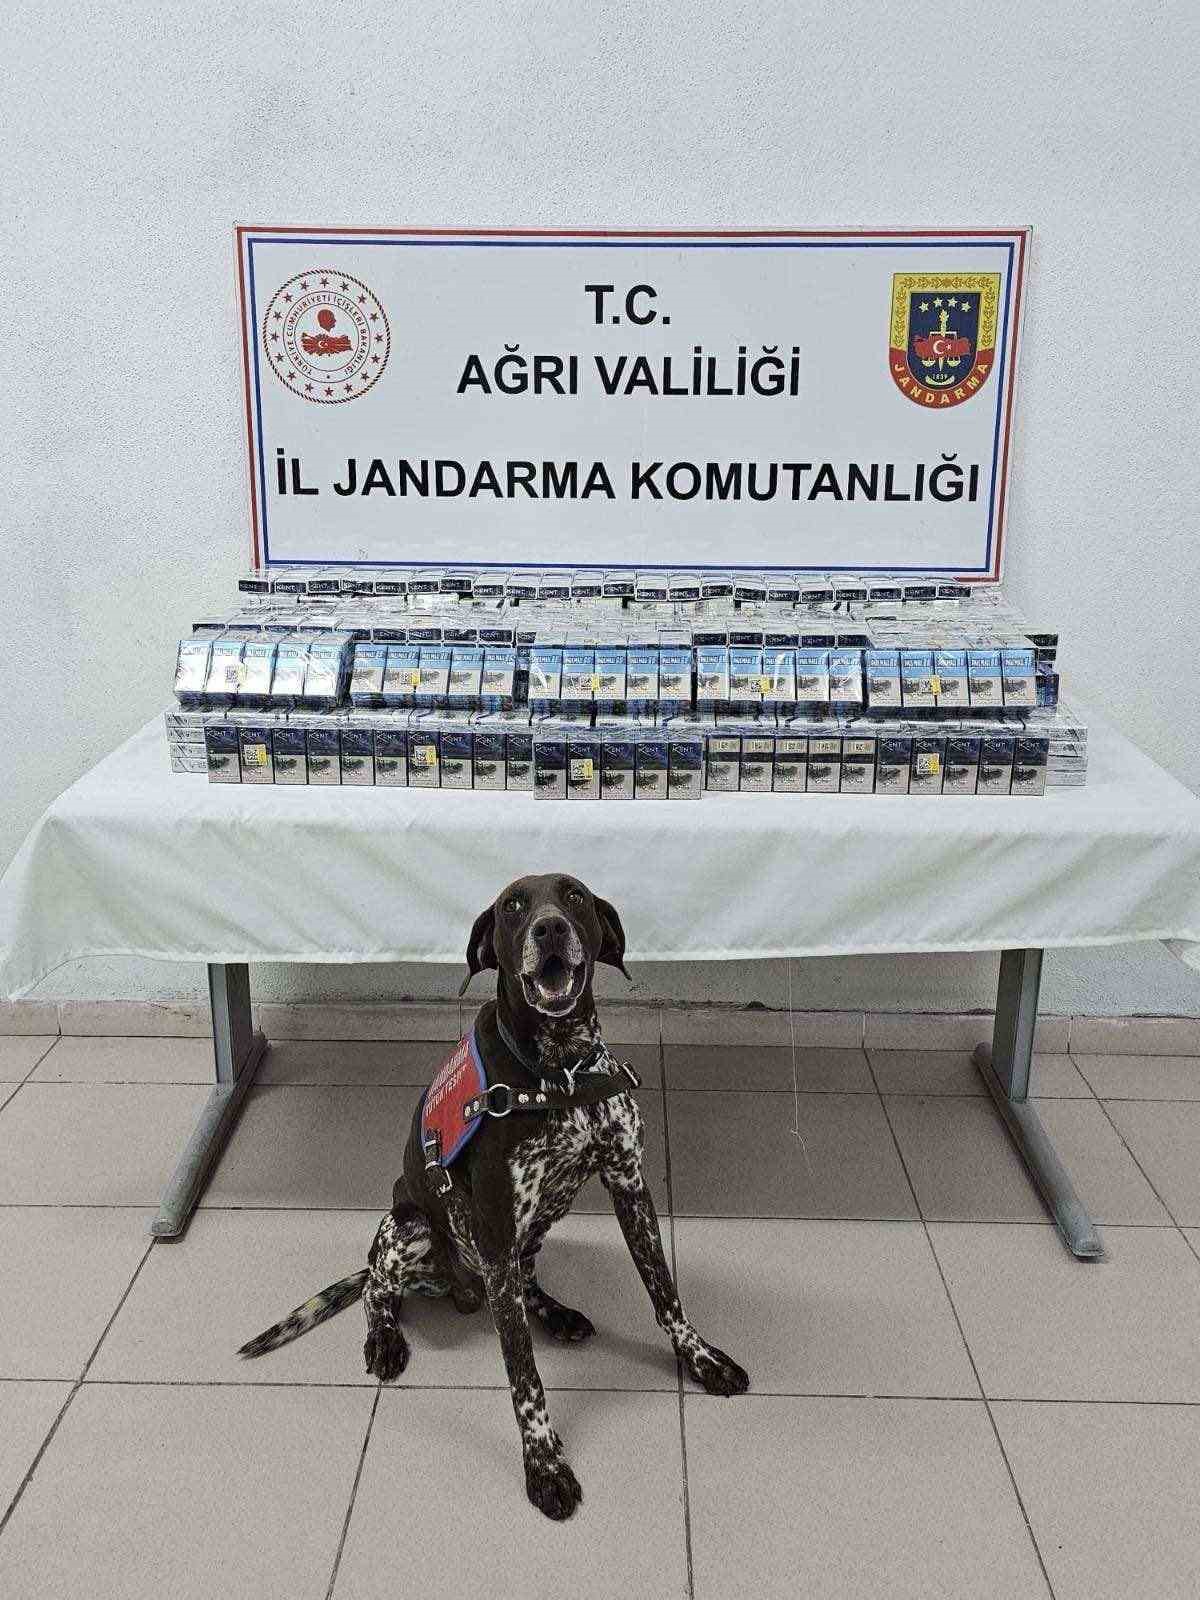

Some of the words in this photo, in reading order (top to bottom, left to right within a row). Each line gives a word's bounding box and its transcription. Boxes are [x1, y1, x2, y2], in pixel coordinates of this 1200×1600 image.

[584, 285, 670, 325] T.C.
[456, 344, 578, 395] AĞRI
[594, 346, 801, 396] VALİLİĞİ
[894, 363, 989, 405] JANDARMA
[276, 448, 320, 496] İL
[334, 459, 617, 499] JANDARMA
[632, 454, 980, 502] KOMUTANLIĞI
